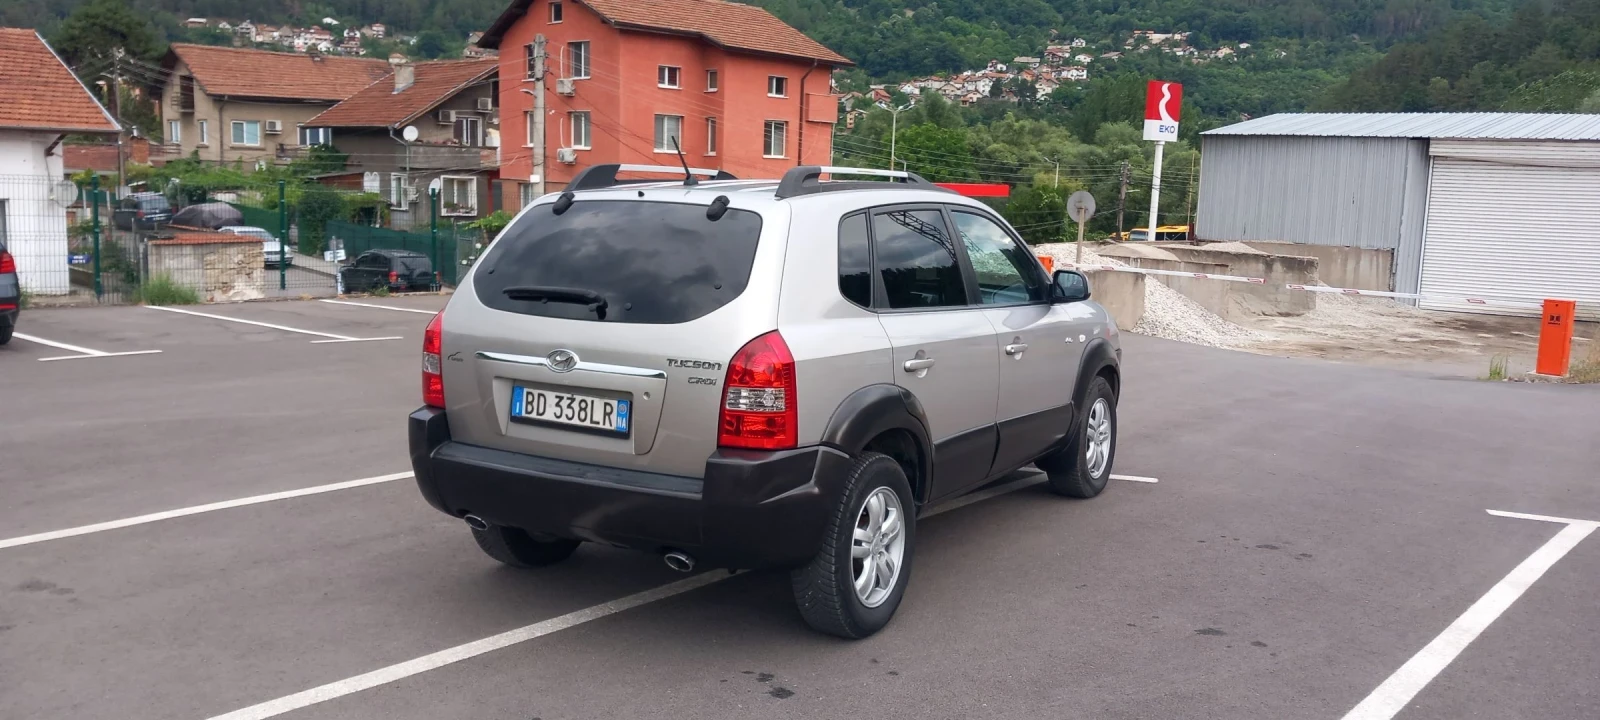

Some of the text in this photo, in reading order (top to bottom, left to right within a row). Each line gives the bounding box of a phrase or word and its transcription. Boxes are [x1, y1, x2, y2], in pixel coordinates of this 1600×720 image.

[1159, 125, 1175, 133] EKO
[667, 358, 722, 370] TUCSON
[525, 391, 614, 427] BD 338LR
[617, 416, 627, 429] NA
